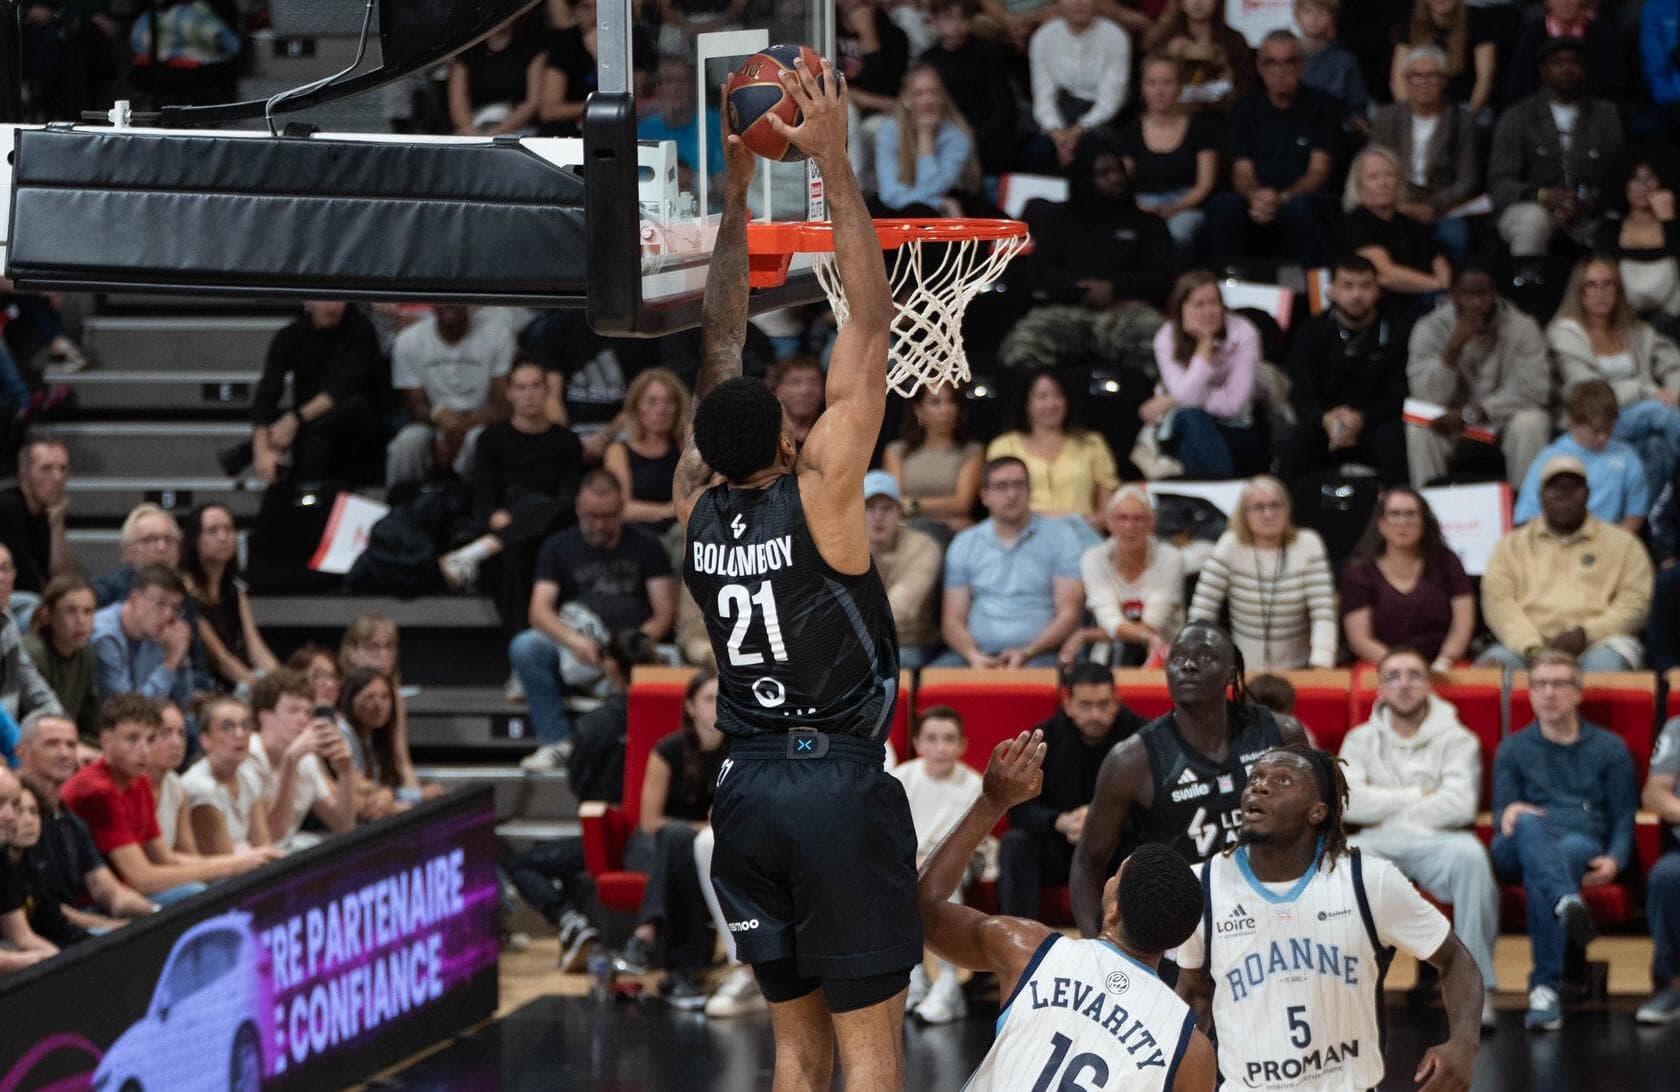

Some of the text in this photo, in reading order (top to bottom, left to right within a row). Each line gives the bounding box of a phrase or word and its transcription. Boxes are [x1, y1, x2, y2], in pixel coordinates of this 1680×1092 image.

[693, 535, 793, 577] BOLOMBOY
[717, 580, 788, 666] 21
[1171, 783, 1210, 802] swile
[1221, 809, 1242, 829] LD
[306, 848, 465, 977] PARTENAIRE
[1225, 938, 1359, 1001] ROANNE
[289, 933, 443, 1063] CONFIANCE
[1029, 977, 1166, 1070] LEVARITY
[1286, 1005, 1312, 1049] 5
[1246, 1040, 1359, 1082] PROMAN
